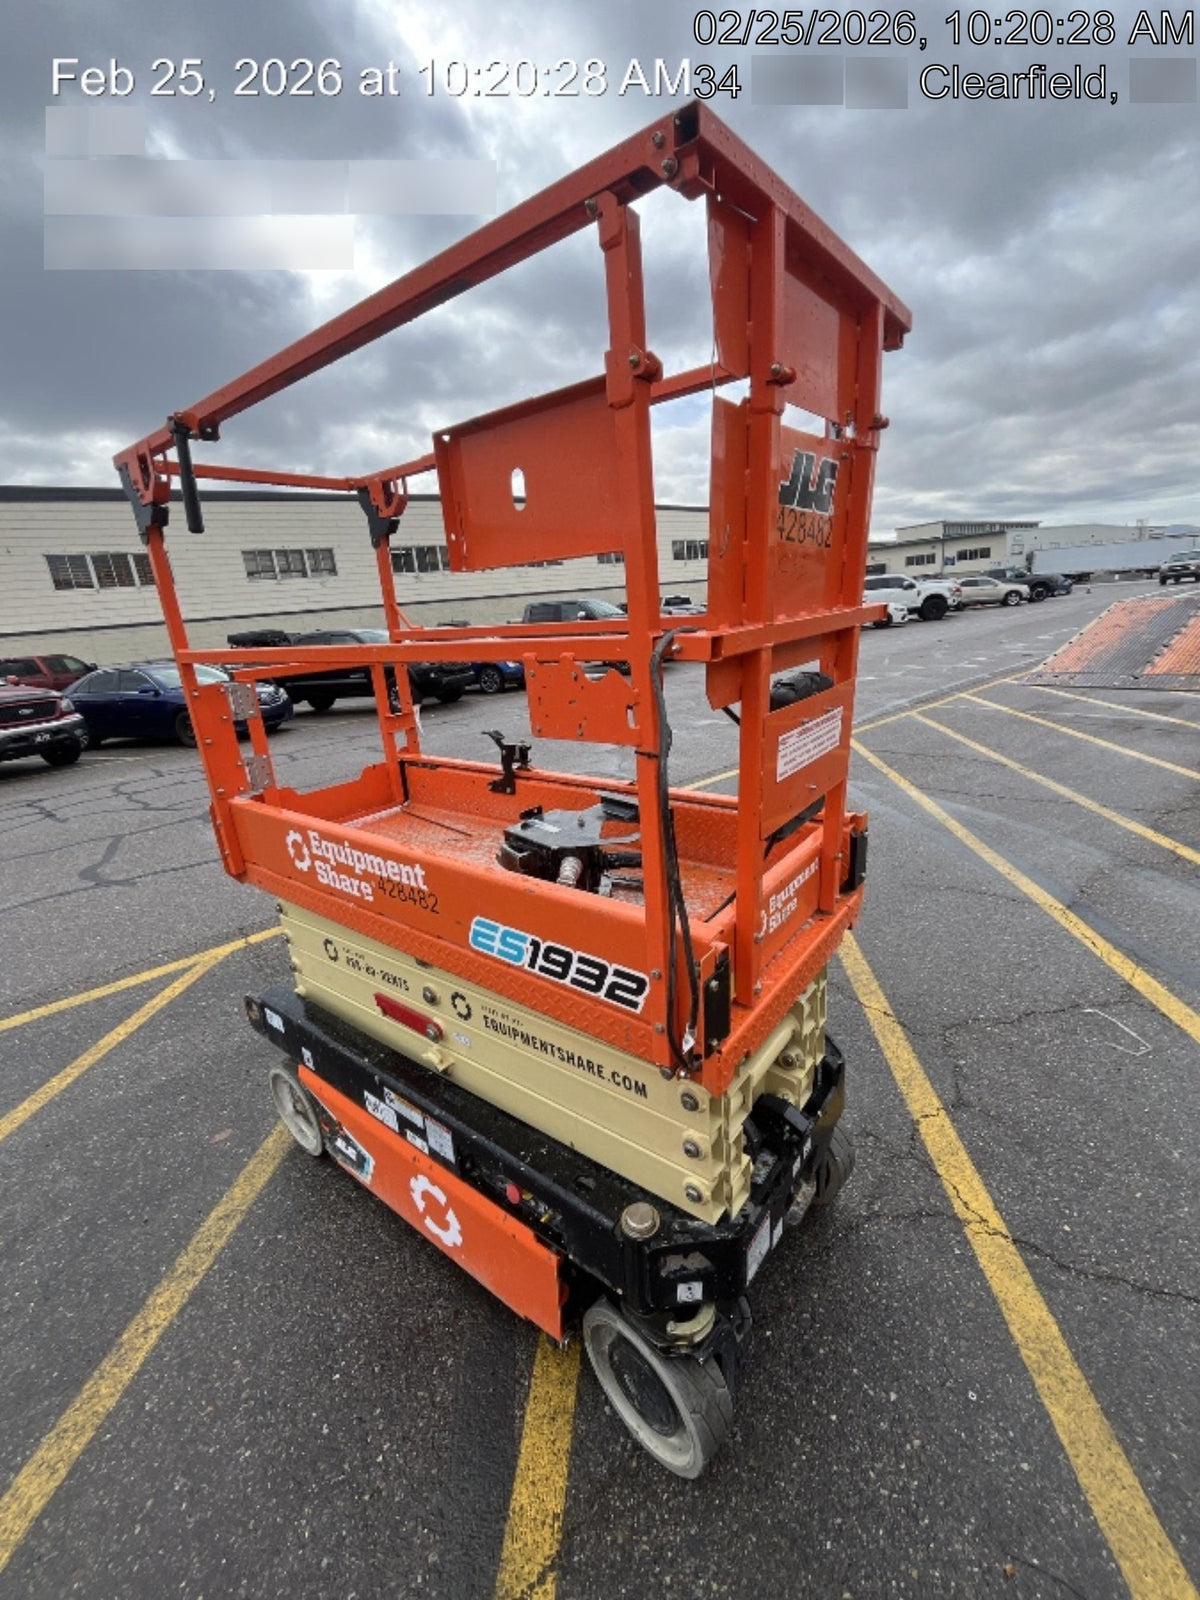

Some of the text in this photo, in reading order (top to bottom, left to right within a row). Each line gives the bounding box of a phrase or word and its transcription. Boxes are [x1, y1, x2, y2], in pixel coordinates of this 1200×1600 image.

[779, 448, 839, 516] JLG
[307, 829, 429, 892] Equipment
[314, 860, 374, 902] Share
[378, 875, 440, 915] 428482
[469, 916, 651, 1013] ES1932
[483, 1014, 648, 1099] EQUIPMENTSHARE.COM
